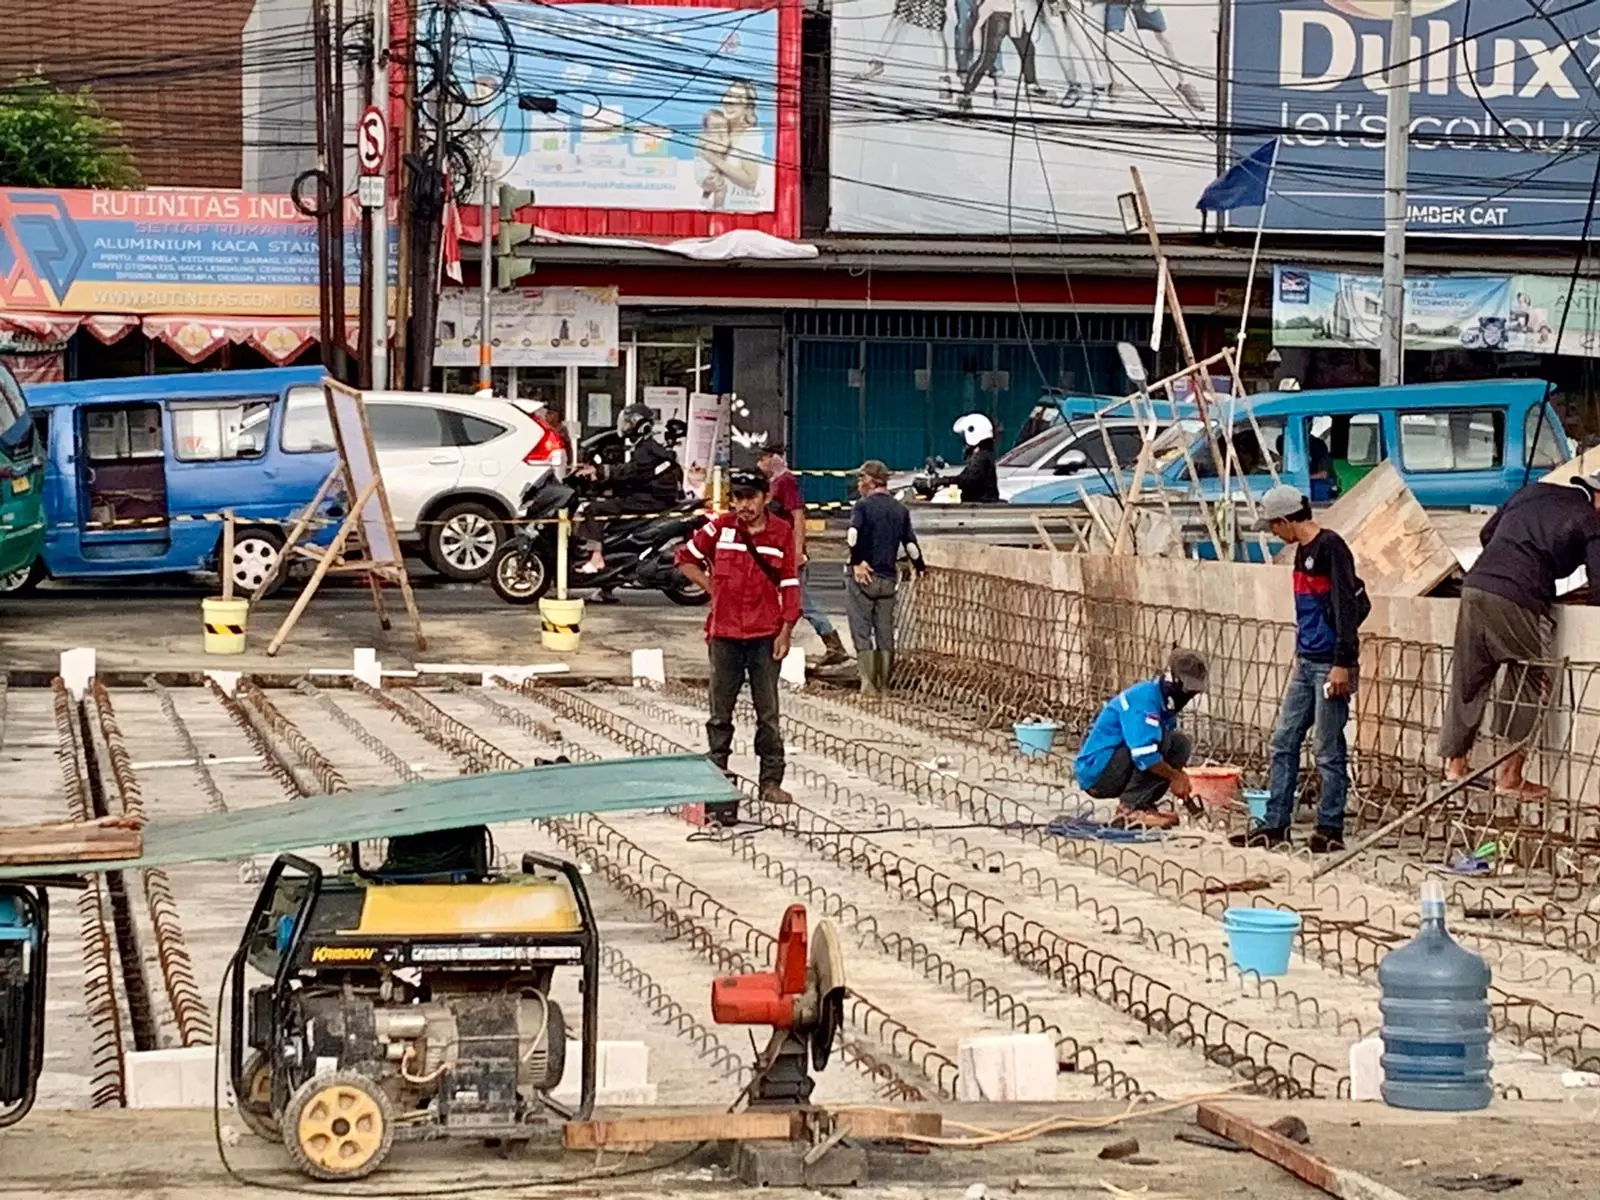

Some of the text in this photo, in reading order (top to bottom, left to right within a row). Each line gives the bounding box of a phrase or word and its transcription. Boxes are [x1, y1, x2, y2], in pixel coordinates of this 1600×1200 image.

[1279, 9, 1581, 100] Dulux
[1280, 101, 1592, 154] let's colour
[91, 193, 241, 218] RUTINITAS
[1404, 205, 1509, 225] UMBER CAT
[93, 237, 202, 251] ALUMINIUM
[211, 240, 259, 253] KACA
